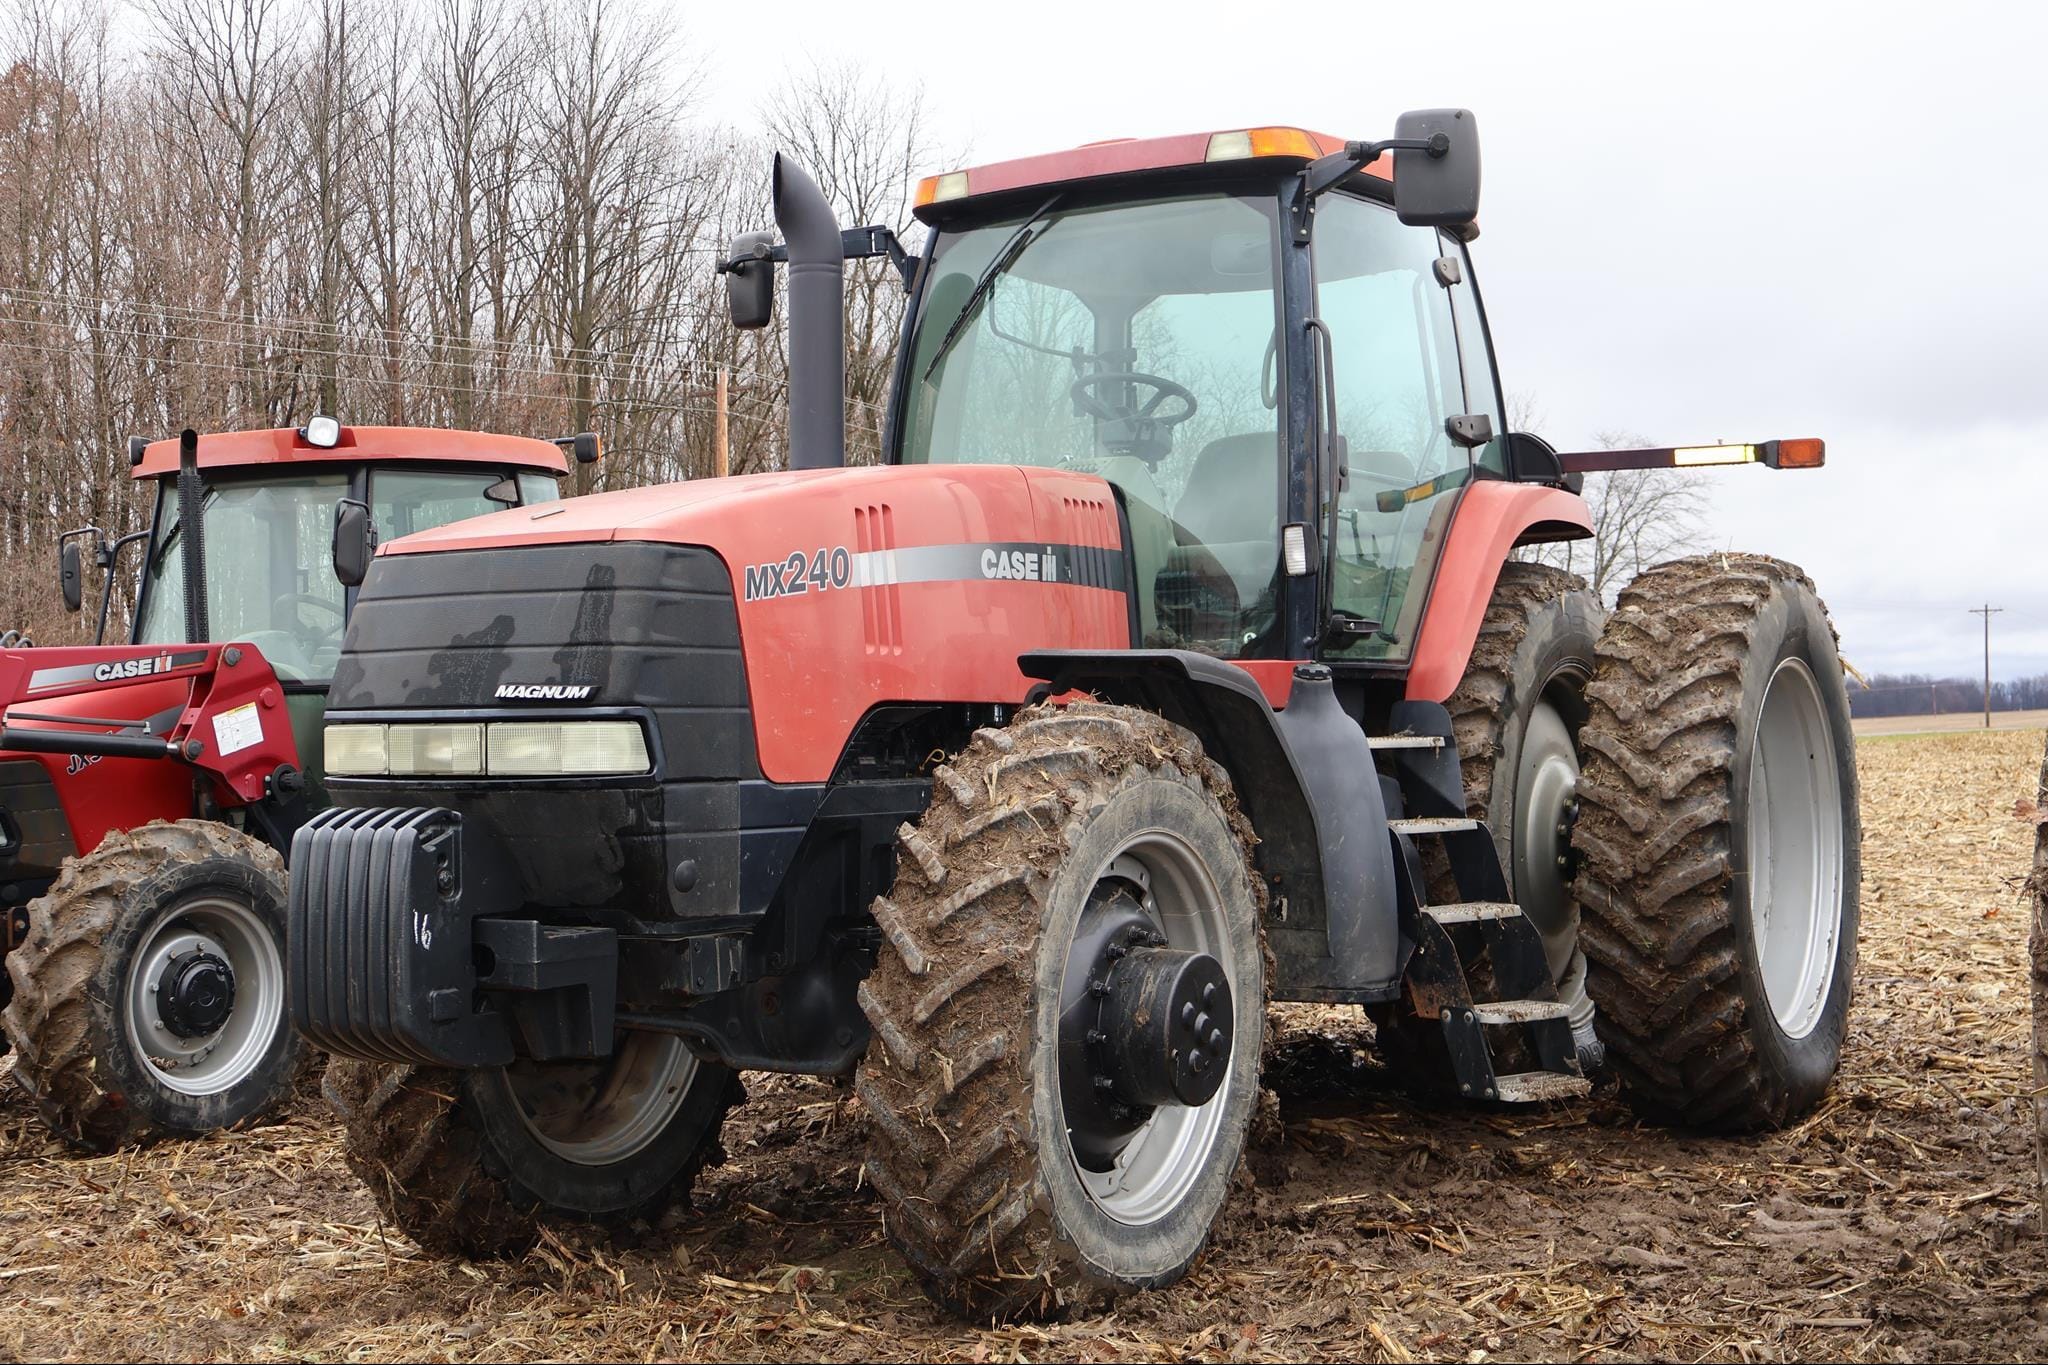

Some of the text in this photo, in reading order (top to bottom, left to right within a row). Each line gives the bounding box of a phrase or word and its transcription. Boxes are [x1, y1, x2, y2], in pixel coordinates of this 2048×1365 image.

[745, 546, 851, 602] MX240
[980, 548, 1039, 581] CASE
[94, 658, 153, 682] CASE
[494, 684, 591, 699] MAGNUM
[412, 908, 432, 951] 16
